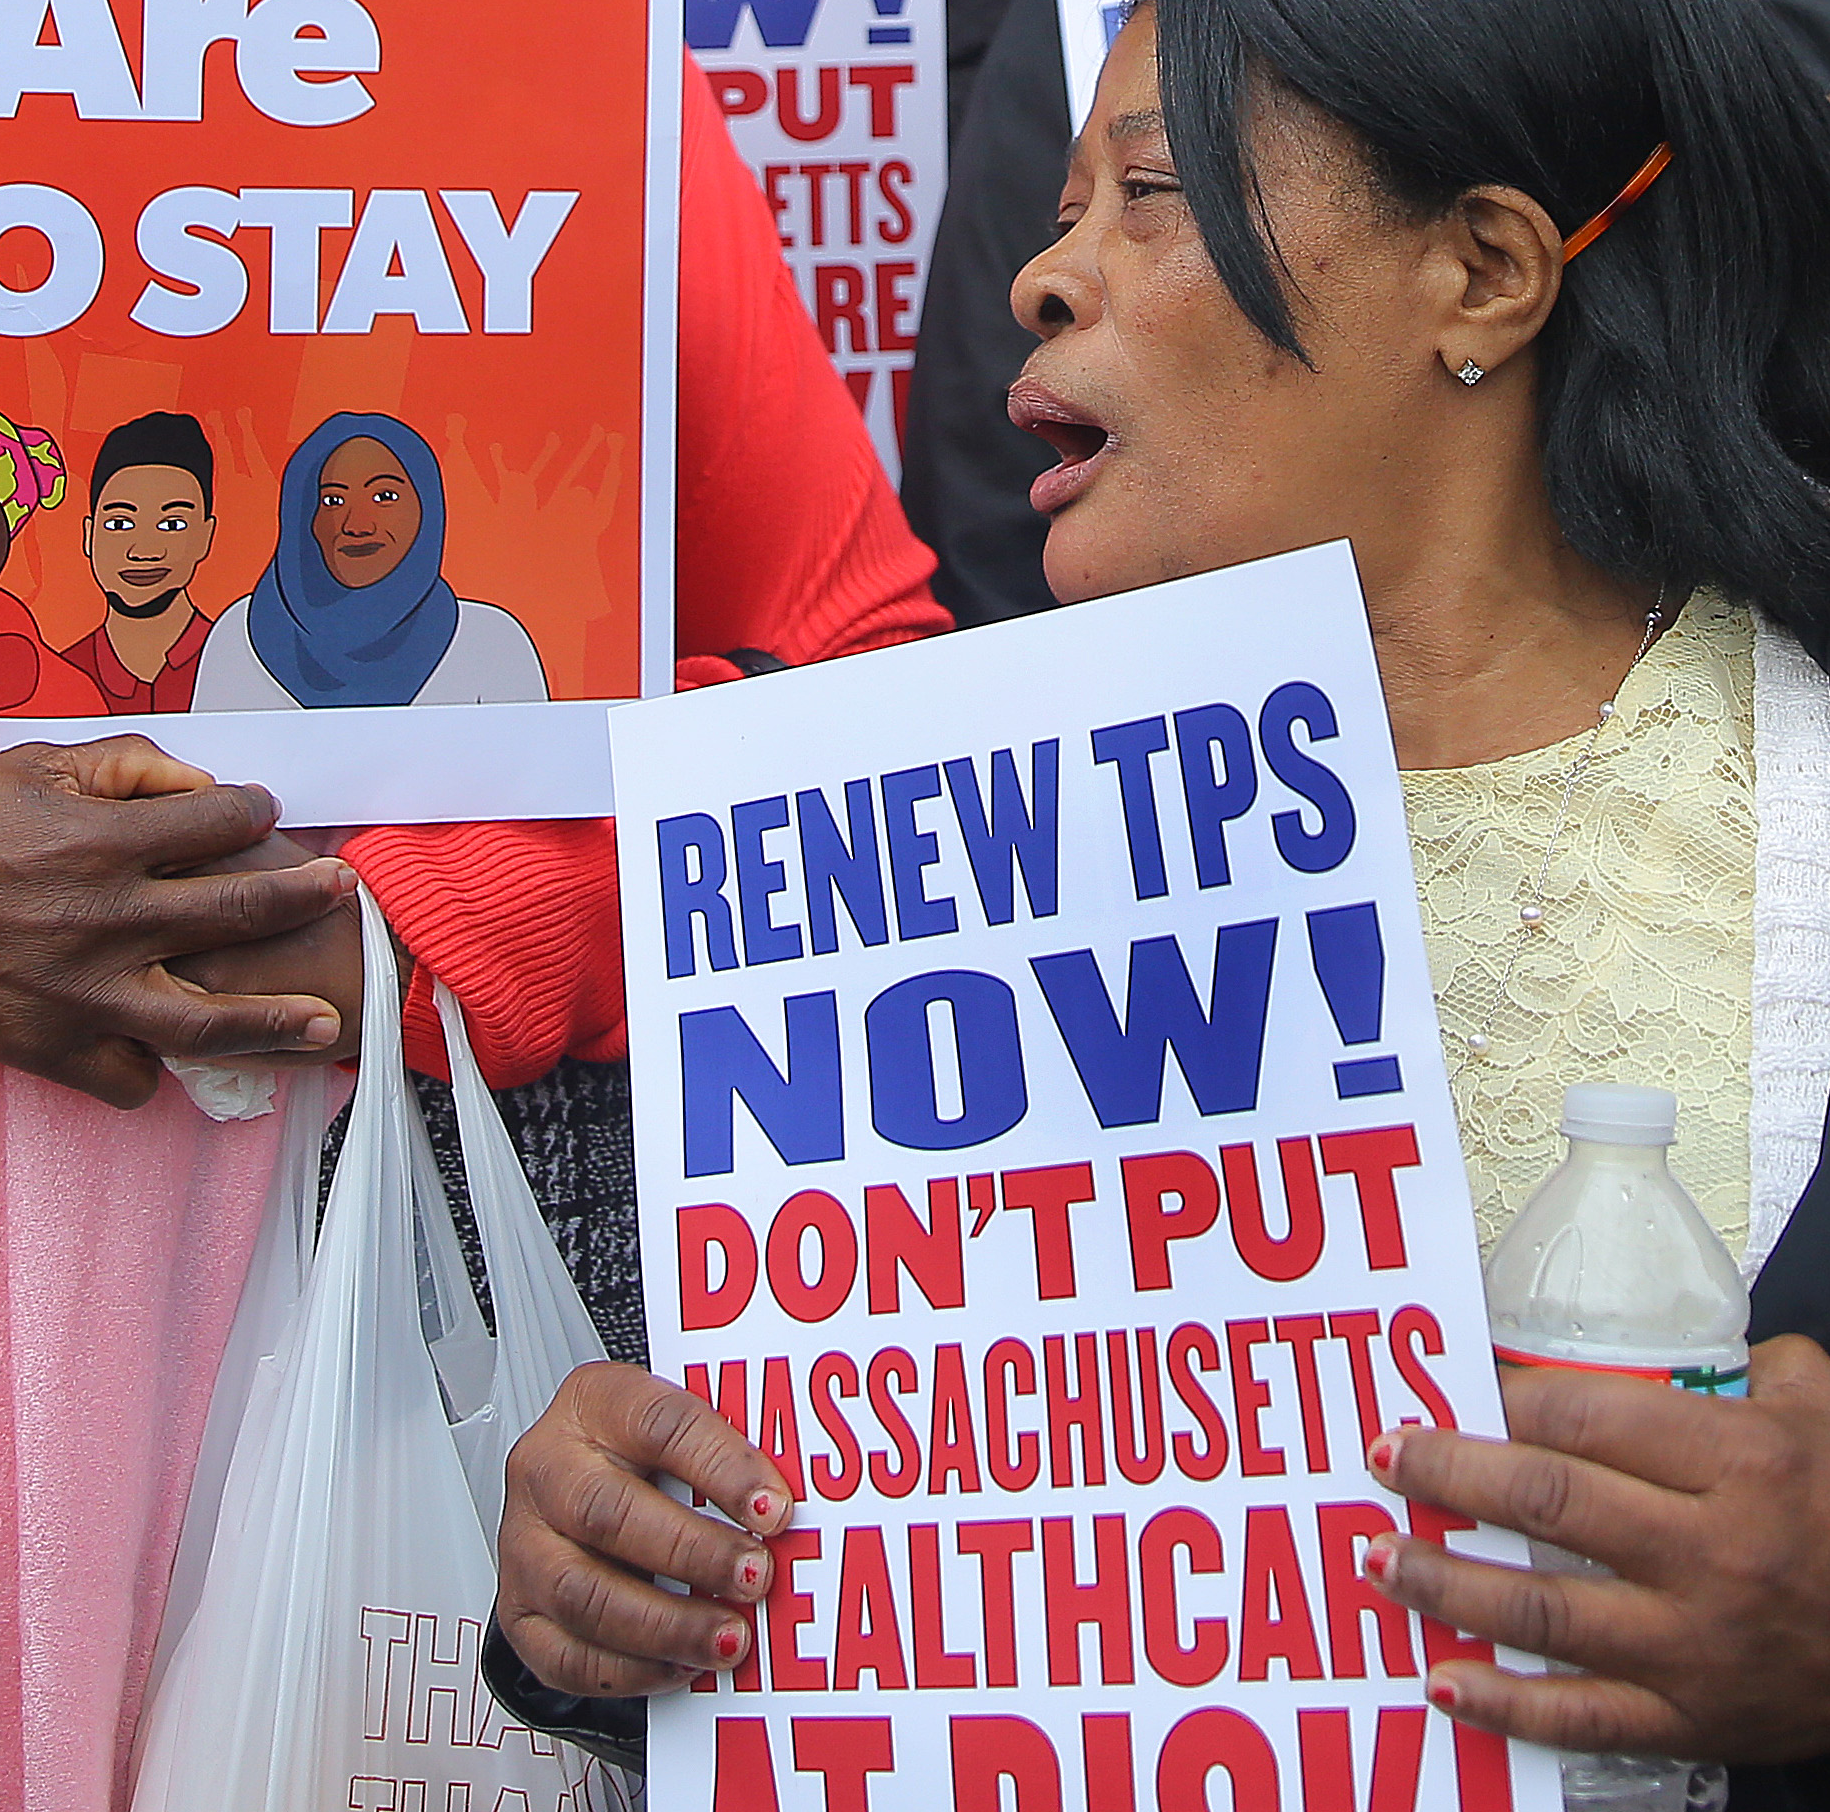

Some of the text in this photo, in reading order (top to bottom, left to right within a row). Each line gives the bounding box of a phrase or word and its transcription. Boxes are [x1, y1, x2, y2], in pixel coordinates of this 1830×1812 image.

[703, 65, 914, 141] PUT
[129, 186, 579, 337] STAY
[656, 680, 1357, 980] RENEW TPS
[678, 900, 1404, 1179] NOW!
[676, 1122, 1422, 1332] DON'T PUT
